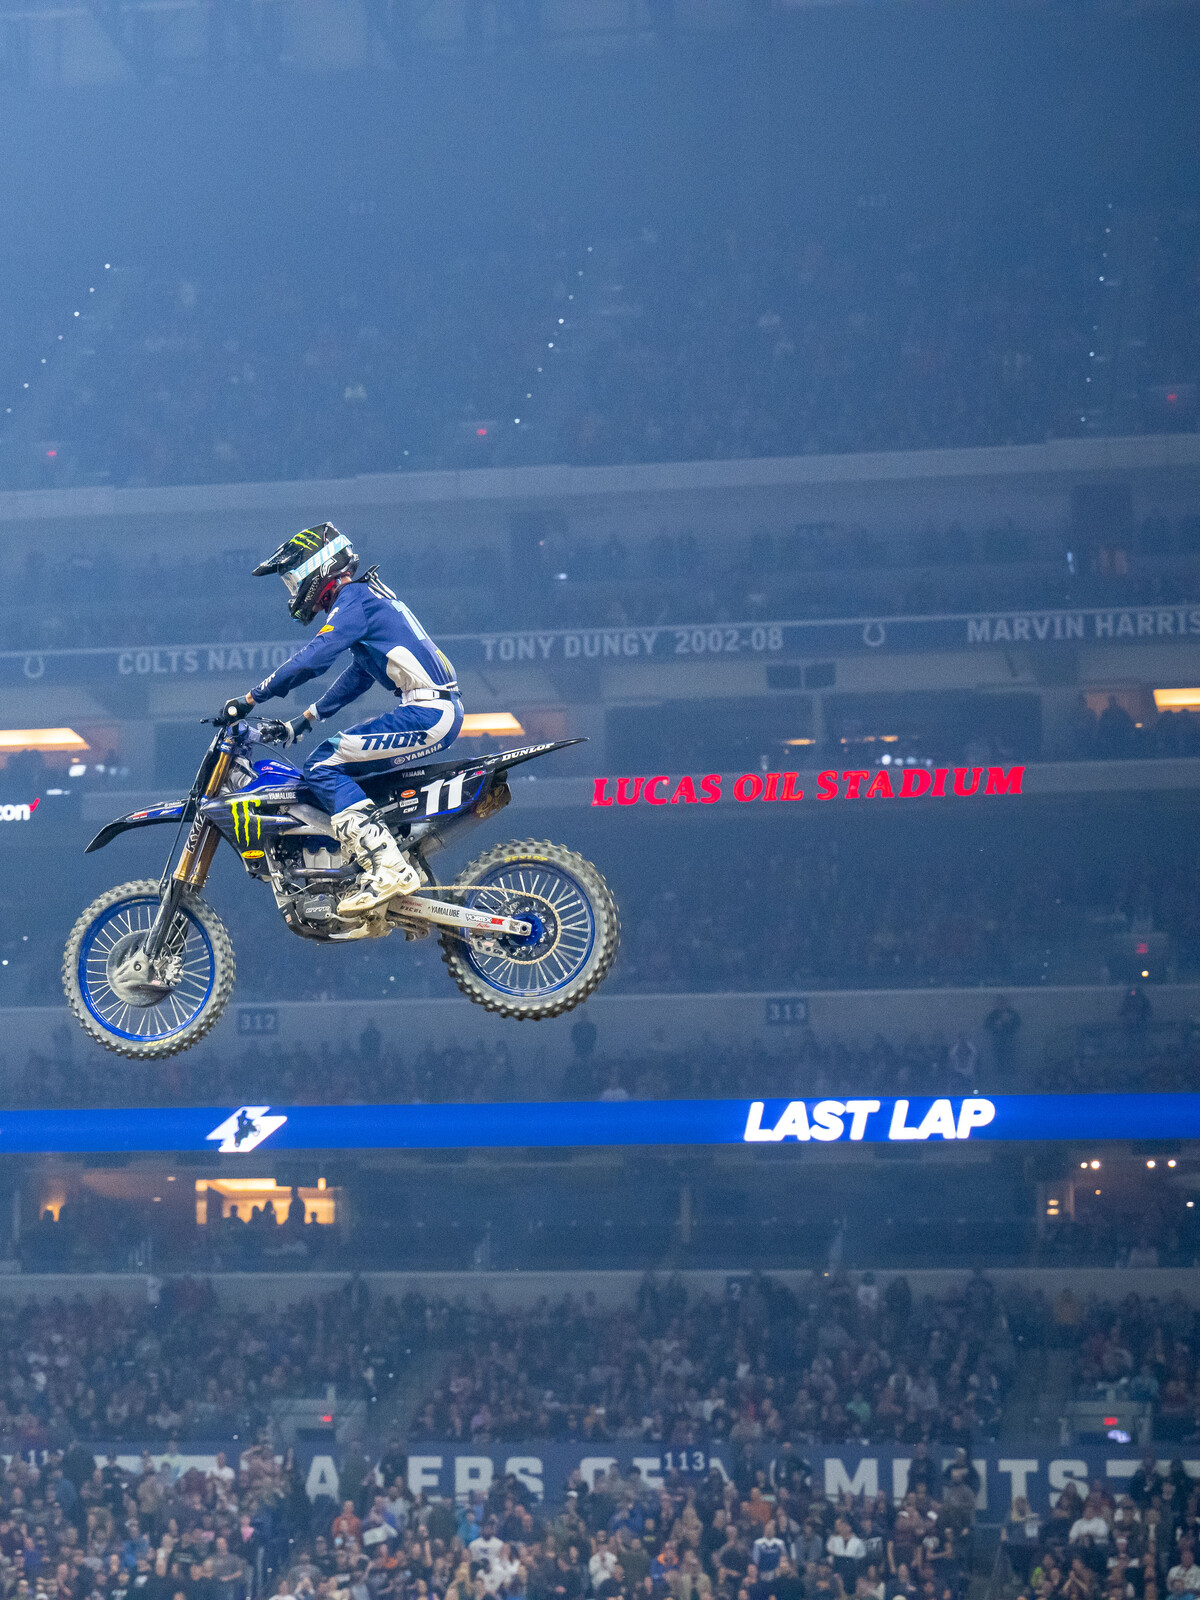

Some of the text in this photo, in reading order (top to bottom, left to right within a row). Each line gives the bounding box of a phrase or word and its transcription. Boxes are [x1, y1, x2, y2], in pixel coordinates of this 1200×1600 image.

[966, 616, 1086, 643] MARVIN
[480, 626, 784, 661] TONY DUNGY 2002-08
[118, 648, 297, 675] COLTS NATIO
[361, 731, 428, 751] THOR
[404, 743, 443, 761] YAMAHA
[501, 742, 555, 762] DUNLOP
[420, 773, 467, 816] 11
[591, 766, 1026, 807] LUCAS OIL STADIUM
[240, 1013, 276, 1031] 312
[769, 1003, 807, 1020] 313
[744, 1098, 996, 1142] LAST LAP
[664, 1451, 706, 1472] 113
